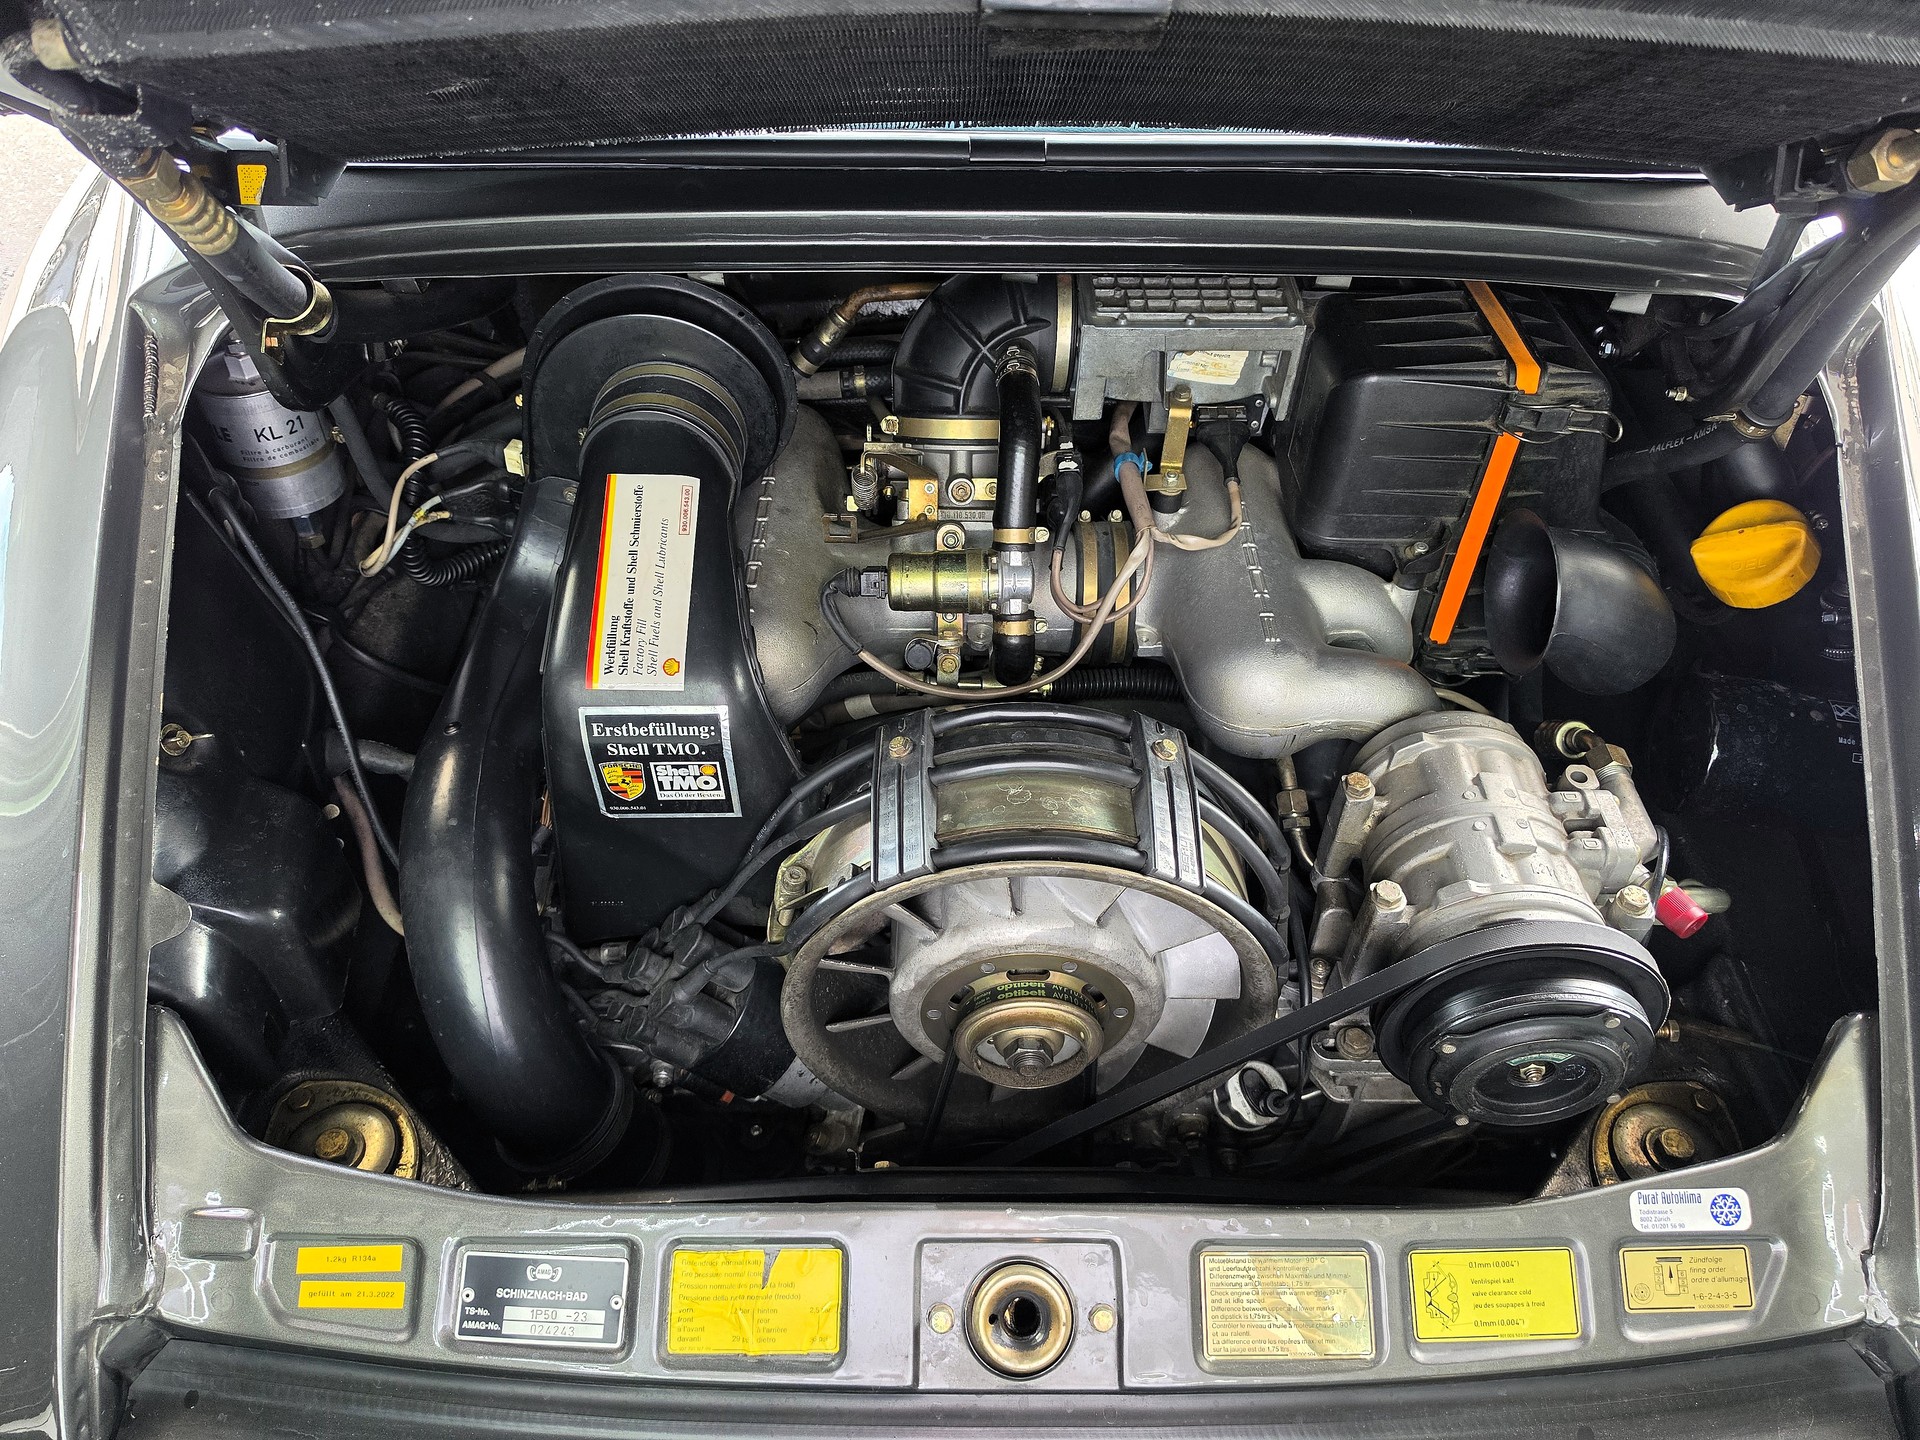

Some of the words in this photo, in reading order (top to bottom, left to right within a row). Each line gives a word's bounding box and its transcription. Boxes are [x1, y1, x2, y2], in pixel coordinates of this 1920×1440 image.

[254, 426, 284, 443] KL
[286, 415, 305, 435] 21
[272, 437, 309, 453] carburant
[280, 437, 320, 459] combustible
[630, 484, 645, 547] Schmierstoffe
[655, 517, 670, 569] Lubricants
[627, 550, 639, 575] Shell
[628, 577, 637, 595] und
[652, 572, 665, 597] Shell
[654, 598, 662, 619] and
[620, 597, 635, 649] Kraftstoffe
[636, 618, 648, 636] Fill
[649, 620, 662, 647] Fuels
[604, 615, 621, 676] Werkfüllung
[618, 650, 630, 676] Shell
[633, 637, 648, 676] Factory
[647, 648, 659, 677] Shell
[591, 722, 716, 739] Erstbefüllung:
[606, 743, 650, 756] Shell
[652, 743, 706, 756] TMO.
[1838, 736, 1856, 746] Made
[656, 765, 700, 776] Shell
[657, 776, 718, 790] TMO
[997, 990, 1046, 1000] optibelt
[1638, 1191, 1659, 1205] Purat
[1662, 1191, 1702, 1205] Autoklima
[308, 1290, 336, 1298] gefüllt
[774, 1293, 801, 1301] (freddo)
[465, 1306, 490, 1316] TS-No.
[530, 1310, 558, 1320] 1P50
[566, 1312, 588, 1323] -23
[462, 1320, 502, 1331] AMAG-No.
[530, 1325, 575, 1337] 024243
